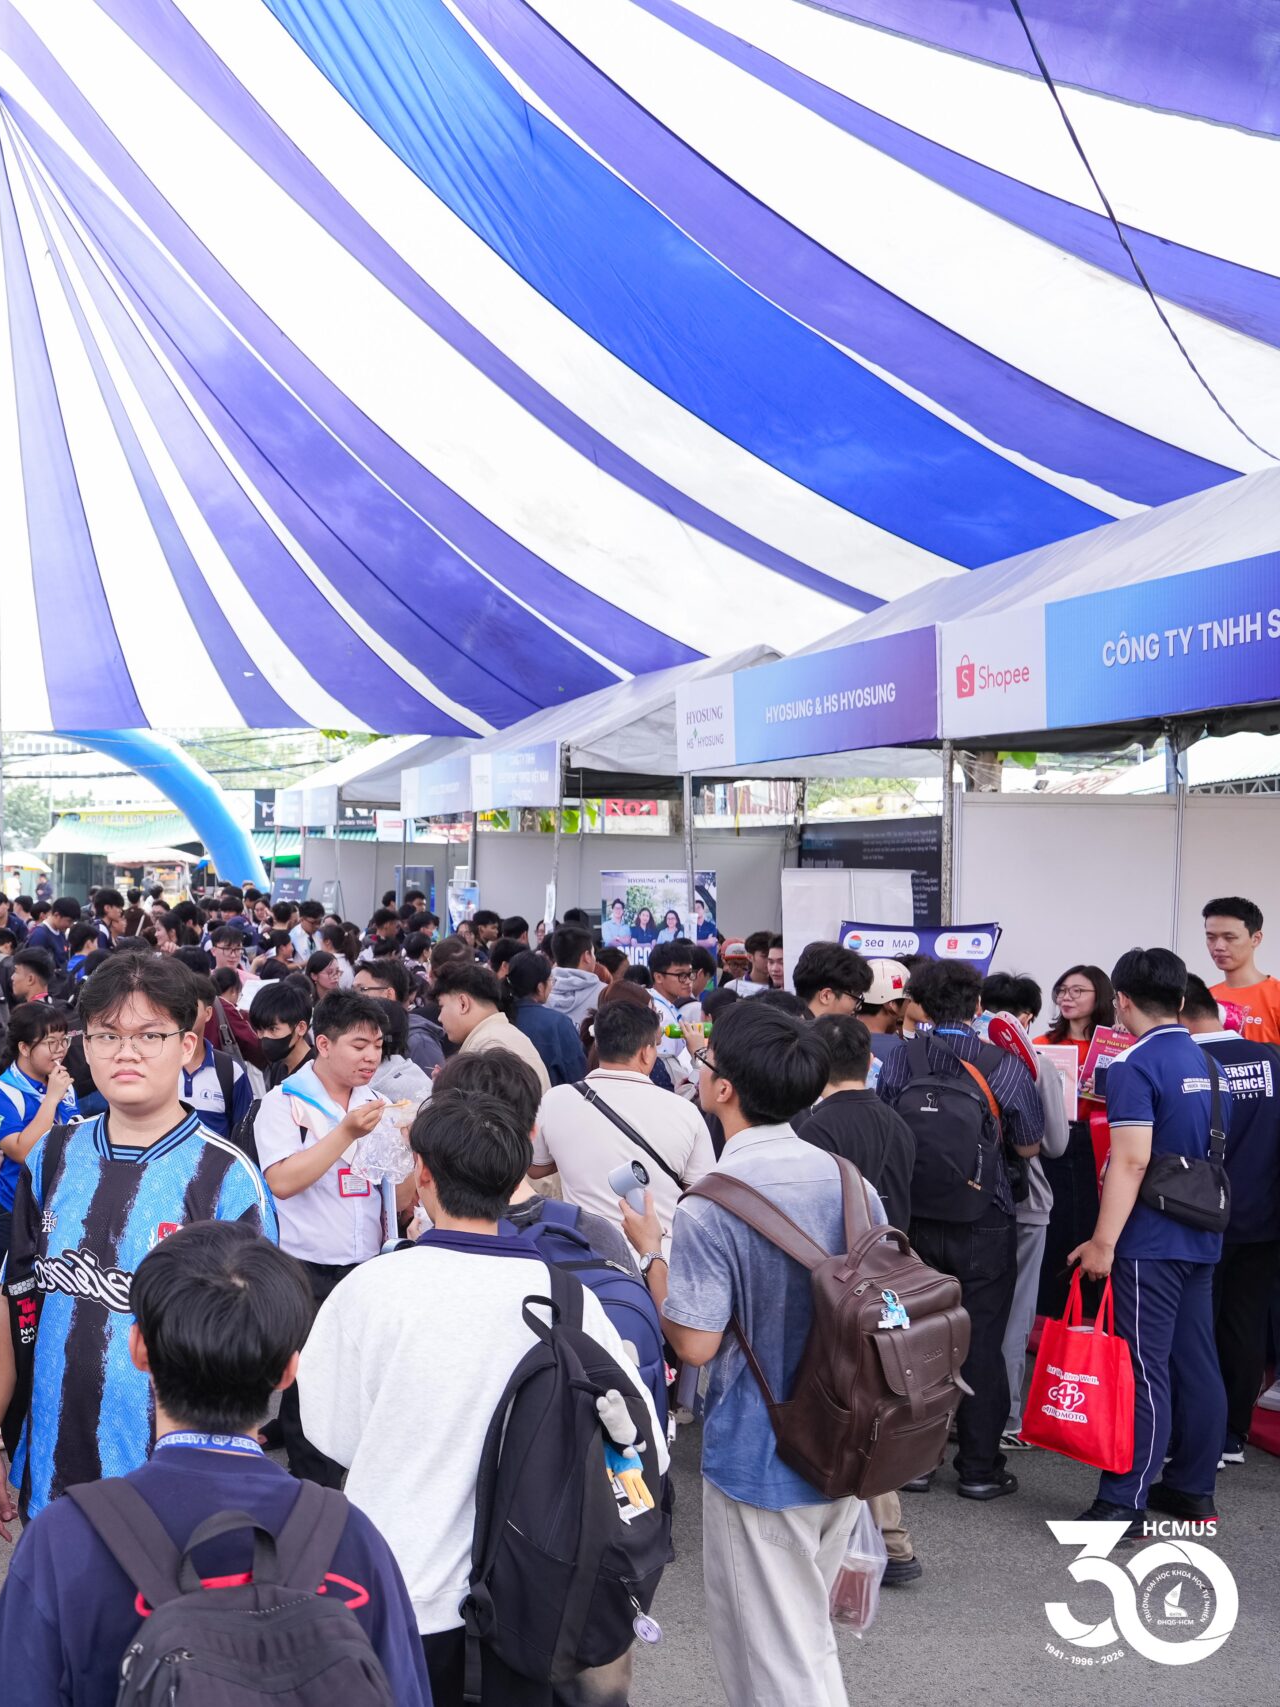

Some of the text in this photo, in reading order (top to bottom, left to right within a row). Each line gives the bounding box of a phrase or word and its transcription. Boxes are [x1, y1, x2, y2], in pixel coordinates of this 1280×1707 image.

[1102, 630, 1160, 667] CÔNG
[1164, 626, 1193, 657] TY
[1198, 611, 1262, 649] TNHH
[978, 663, 1030, 693] Shopee
[766, 682, 896, 724] HYOSUNG & HS HYOSUNG
[686, 706, 723, 725] HYOSUNG
[686, 734, 724, 749] HS HYOSUNG
[865, 938, 914, 949] sea MAP
[1224, 1064, 1261, 1078] ERSITY
[1230, 1077, 1265, 1090] IENCE
[212, 1435, 231, 1446] OF
